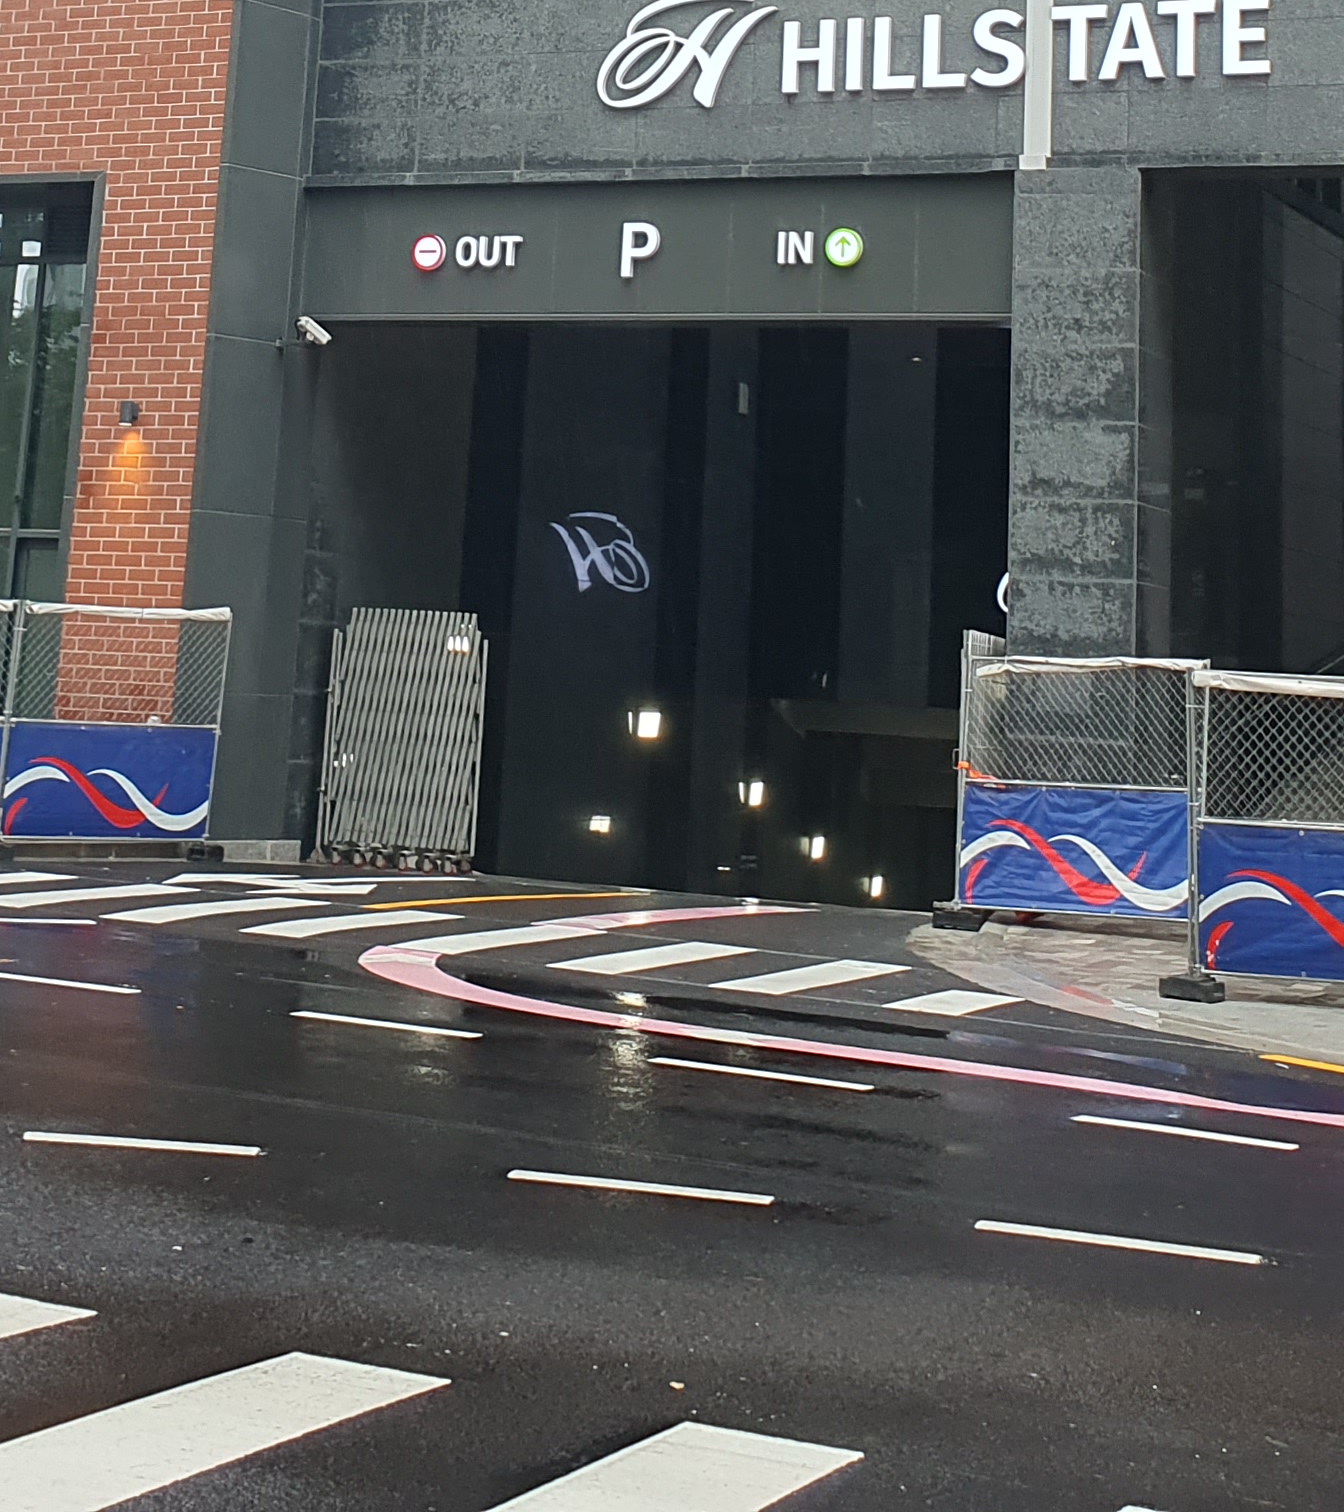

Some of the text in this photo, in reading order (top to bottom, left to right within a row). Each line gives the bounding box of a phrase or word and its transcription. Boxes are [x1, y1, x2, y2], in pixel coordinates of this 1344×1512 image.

[455, 234, 524, 268] OUT
[619, 222, 661, 278] P
[776, 231, 815, 266] IN
